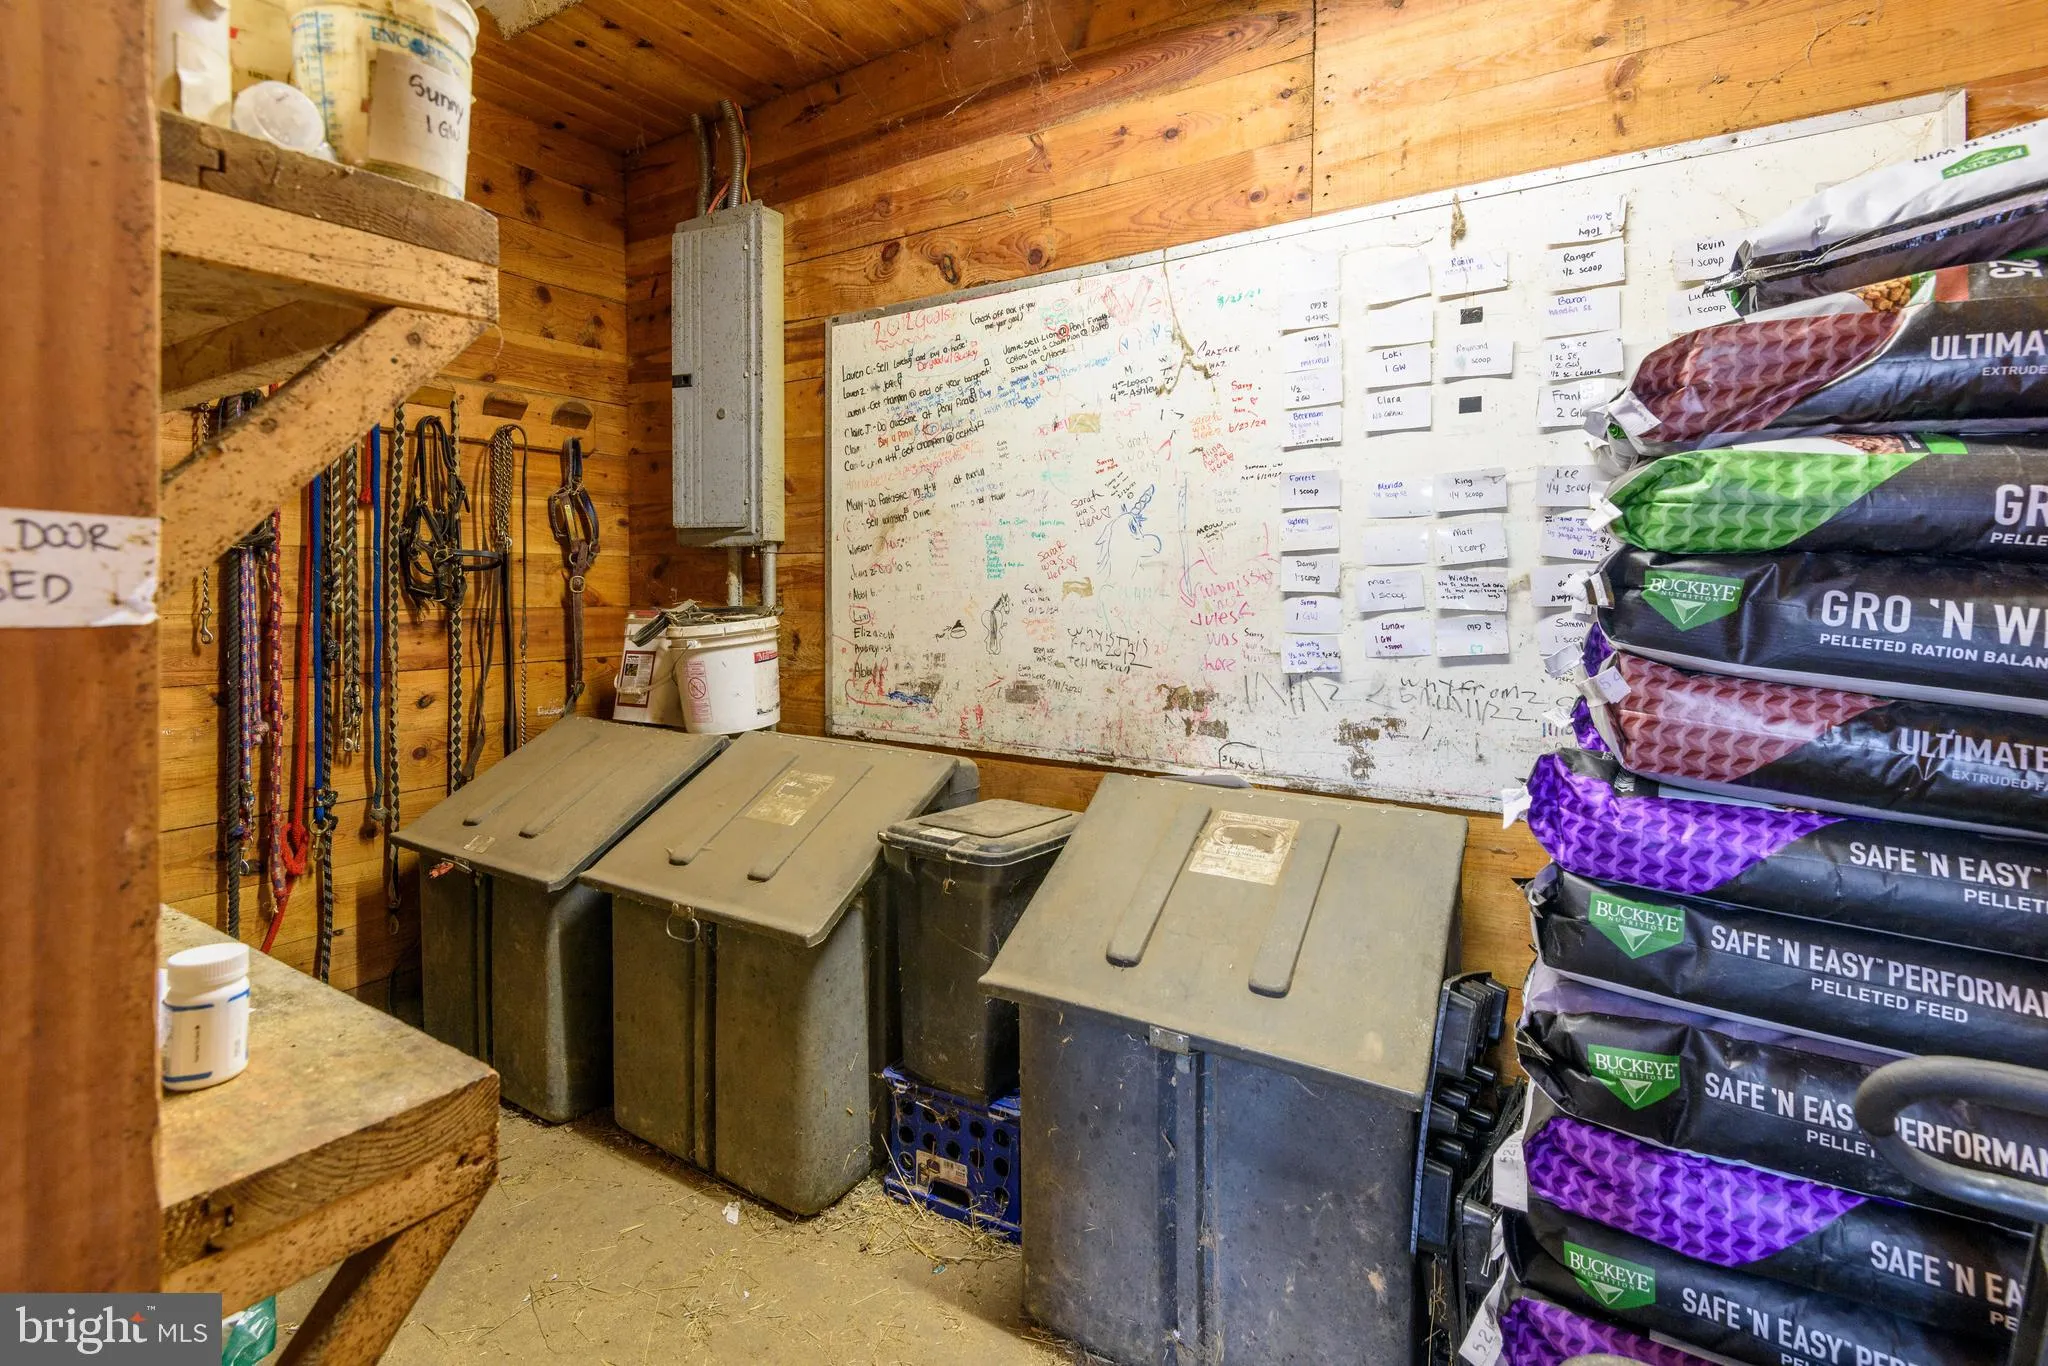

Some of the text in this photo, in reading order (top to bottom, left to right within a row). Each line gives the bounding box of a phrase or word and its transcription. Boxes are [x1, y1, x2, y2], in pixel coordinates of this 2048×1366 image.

[425, 114, 433, 133] 1
[1697, 240, 1726, 252] Kevin
[1563, 251, 1596, 263] Ranger
[1696, 256, 1725, 267] scoop
[1579, 264, 1603, 274] scoop
[1557, 295, 1587, 306] Baron
[1697, 304, 1727, 315] scoop
[1930, 328, 2048, 361] ULTIMA
[1382, 351, 1402, 360] Loki
[1471, 356, 1491, 365] scoop
[1377, 396, 1402, 405] Clara
[1556, 408, 1564, 417] 2
[1289, 474, 1316, 483] Forrest
[1454, 477, 1474, 487] King
[1300, 488, 1320, 497] scoop
[1464, 491, 1484, 499] scoop
[12, 518, 121, 551] DOOR
[1572, 547, 1595, 560] Nemo
[0, 570, 73, 605] ED
[1648, 576, 1736, 603] BUCKEYE
[1661, 589, 1719, 602] NUTRITION
[1821, 590, 1912, 634] GRO
[1819, 632, 1906, 654] PELLETED
[1911, 643, 1979, 661] RATION
[1899, 725, 2048, 776] ULTIMATE
[1952, 769, 2031, 791] EXTRUDED
[1850, 841, 1916, 872] SAFE
[1595, 900, 1679, 934] BUCKEYE
[1607, 915, 1664, 933] NUTRITION
[1711, 925, 1771, 960] SAFE
[1810, 977, 1969, 1024] PELLETED FEED
[1595, 1051, 1677, 1081] BUCKEYE
[1608, 1067, 1663, 1082] NUTRITION
[1705, 1072, 1765, 1111] SAFE
[1803, 1096, 1854, 1132] EAS
[1894, 1116, 2048, 1179] ERFORMAN
[1570, 1252, 1651, 1293] BUCKEYE
[1581, 1269, 1636, 1291] NUTRITION
[1871, 1240, 1941, 1288] SAFE
[1985, 1271, 2024, 1309] EA
[1682, 1287, 1741, 1330] SAFE
